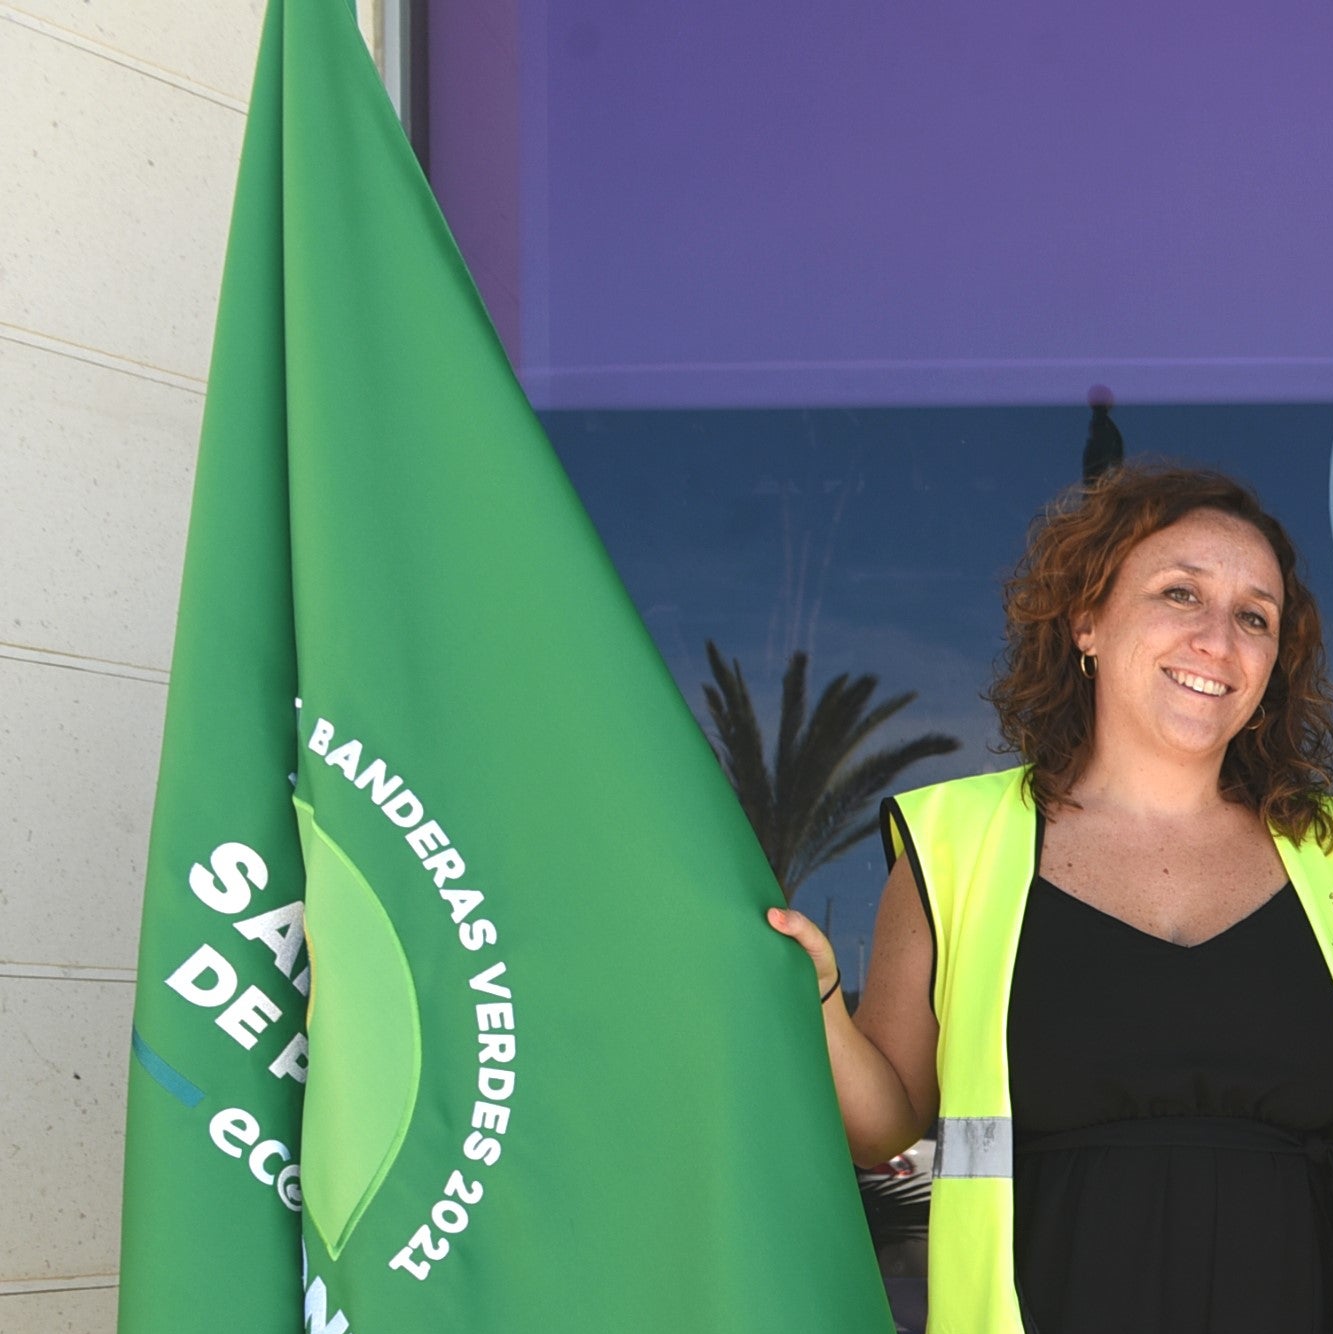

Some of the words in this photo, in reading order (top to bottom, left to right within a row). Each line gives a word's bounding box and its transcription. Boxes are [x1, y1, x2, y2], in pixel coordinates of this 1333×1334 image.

[308, 717, 498, 952] BANDERAS
[164, 943, 283, 1051] DE
[189, 842, 311, 997] SA
[464, 961, 516, 1167] VERDES
[389, 1169, 484, 1280] 2021
